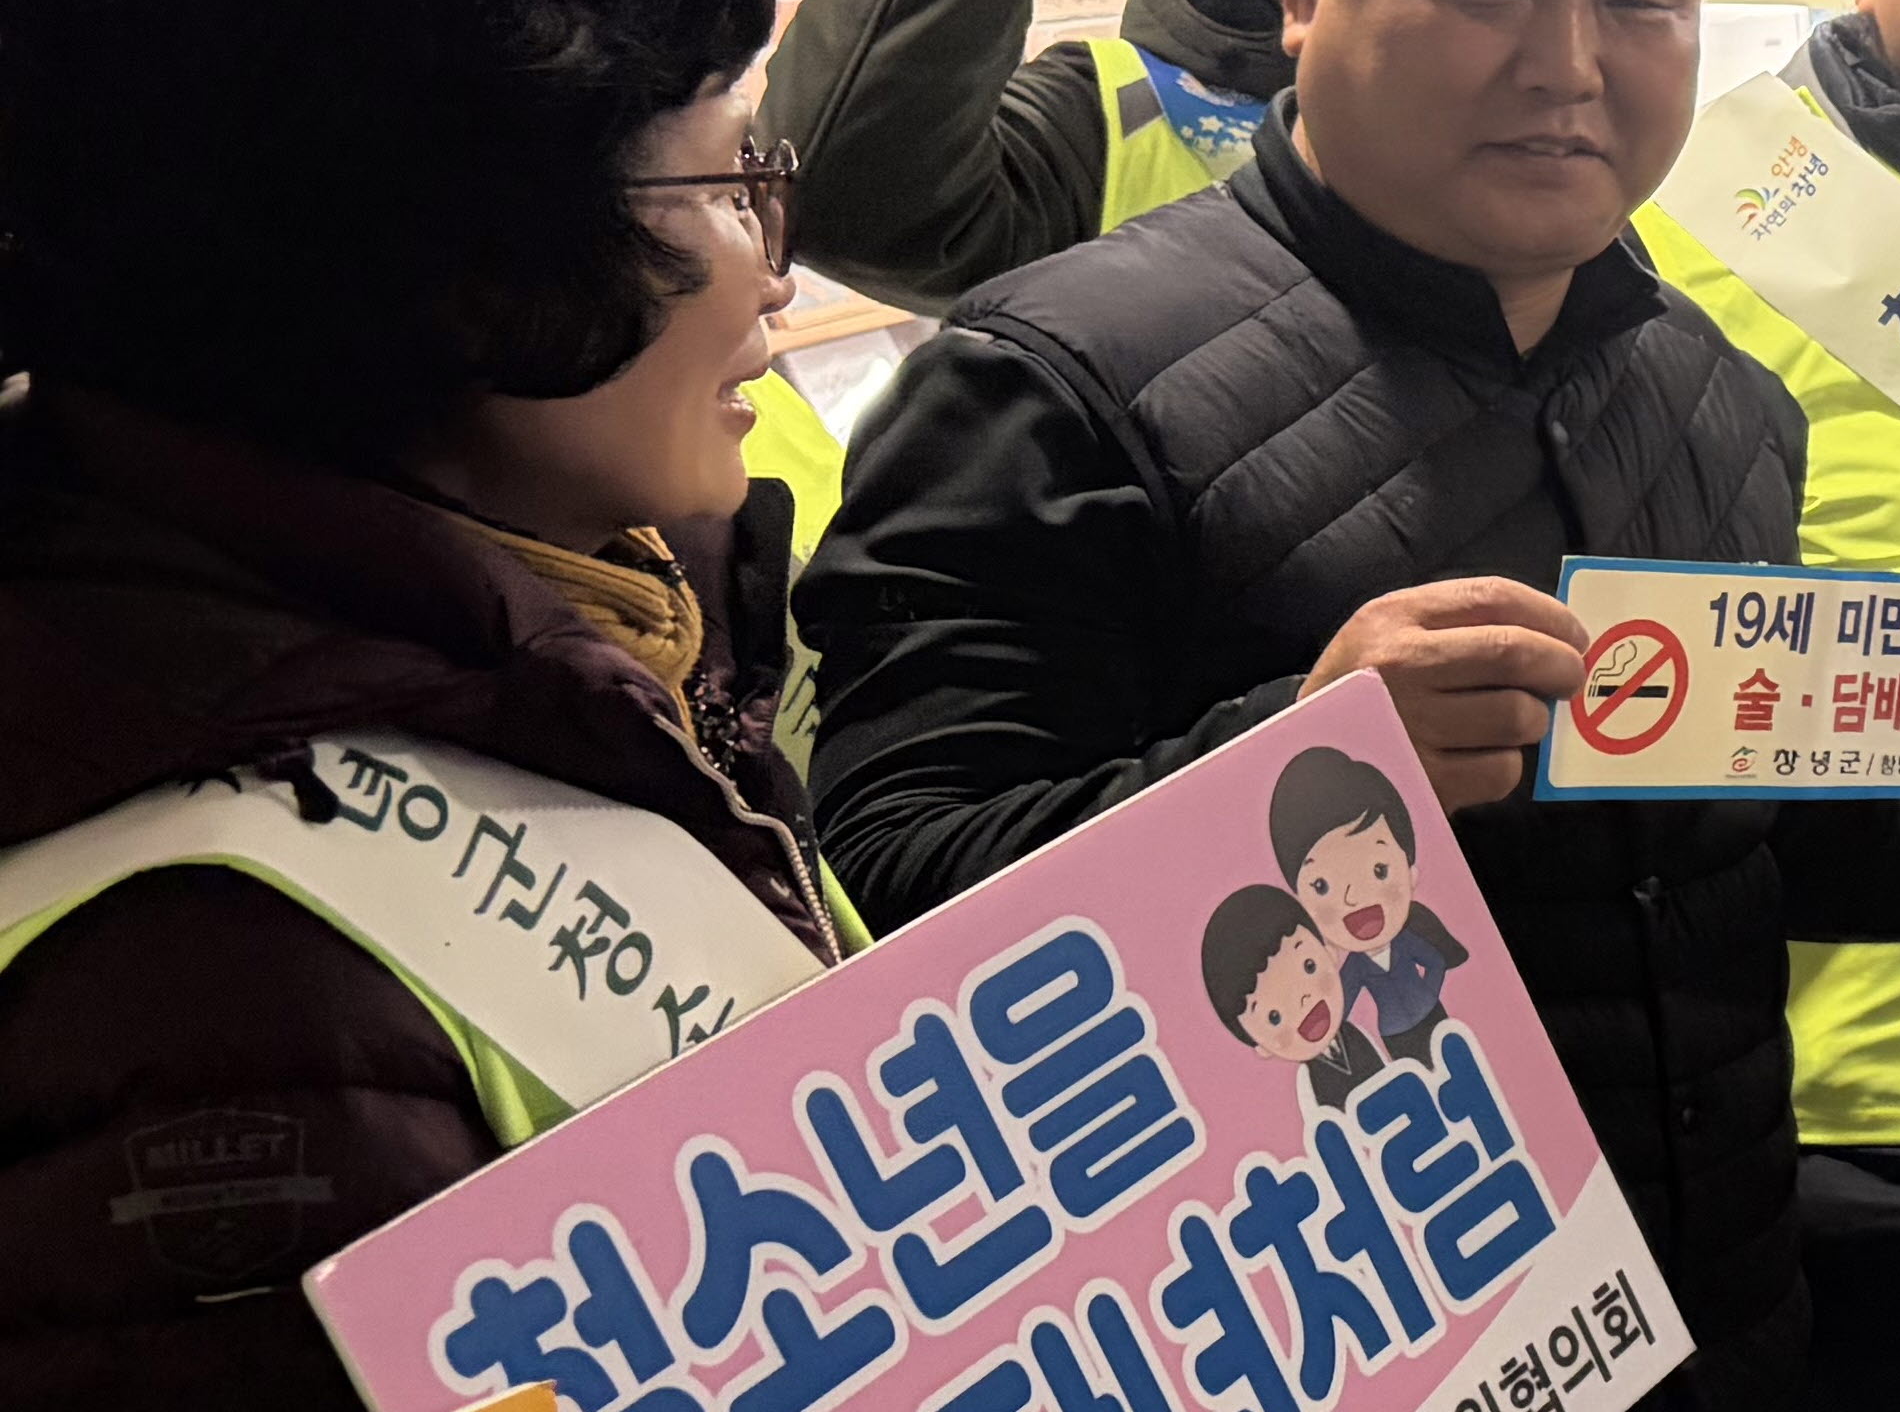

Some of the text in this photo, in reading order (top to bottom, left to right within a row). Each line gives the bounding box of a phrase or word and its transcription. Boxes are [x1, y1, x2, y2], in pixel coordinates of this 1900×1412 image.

[1771, 135, 1808, 178] 안녕
[1750, 153, 1829, 241] 자연의 창녕
[1709, 591, 1813, 655] 19세
